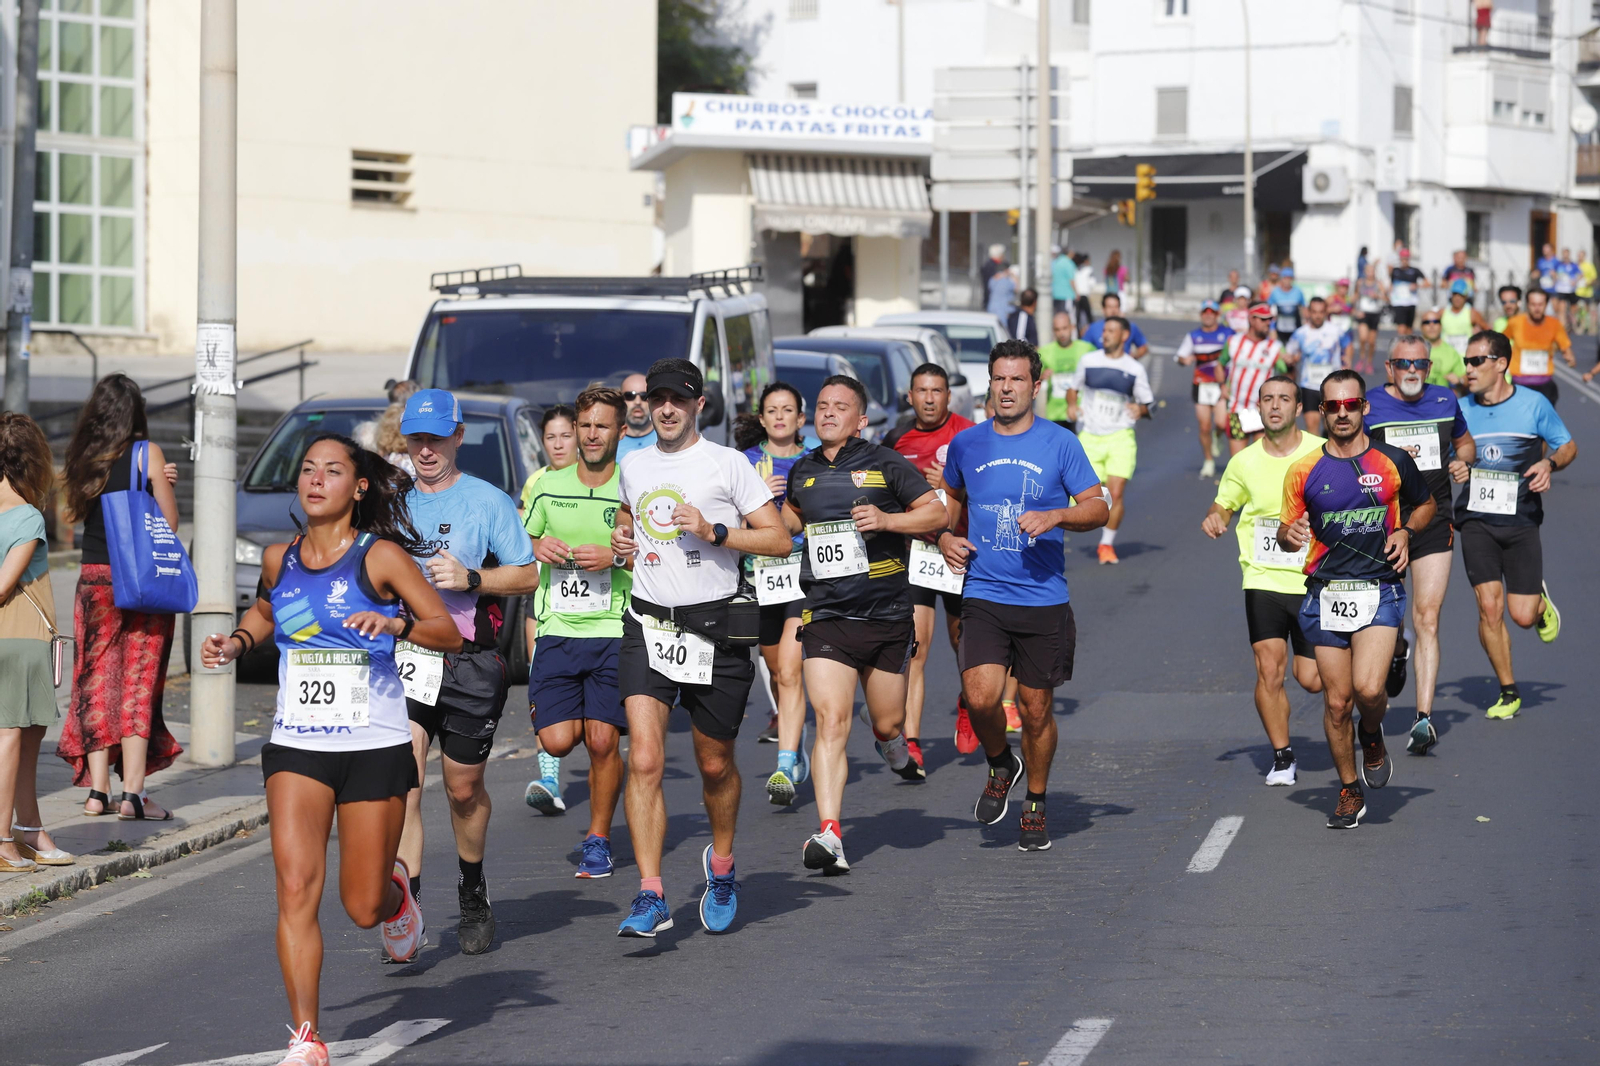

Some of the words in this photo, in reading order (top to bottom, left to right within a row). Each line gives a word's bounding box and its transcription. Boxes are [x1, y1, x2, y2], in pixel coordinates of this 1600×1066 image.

[705, 100, 810, 116] CHURROS
[735, 118, 836, 134] PATATAS
[844, 122, 921, 138] FRITAS
[986, 458, 1011, 468] VUELTA
[1018, 459, 1043, 475] HUELVA
[1361, 476, 1380, 484] KIA
[1360, 486, 1383, 494] VEYSER
[1479, 487, 1495, 501] 84
[551, 500, 578, 509] macron
[817, 544, 844, 564] 605
[919, 560, 945, 578] 254
[561, 580, 590, 598] 642
[767, 574, 792, 591] 541
[1329, 583, 1349, 591] VUELTA
[1349, 583, 1354, 591] A
[1331, 600, 1358, 618] 423
[301, 653, 324, 664] VUELTA
[325, 653, 332, 664] A
[333, 653, 363, 664] HUELVA
[655, 642, 687, 666] 340
[299, 680, 336, 705] 329
